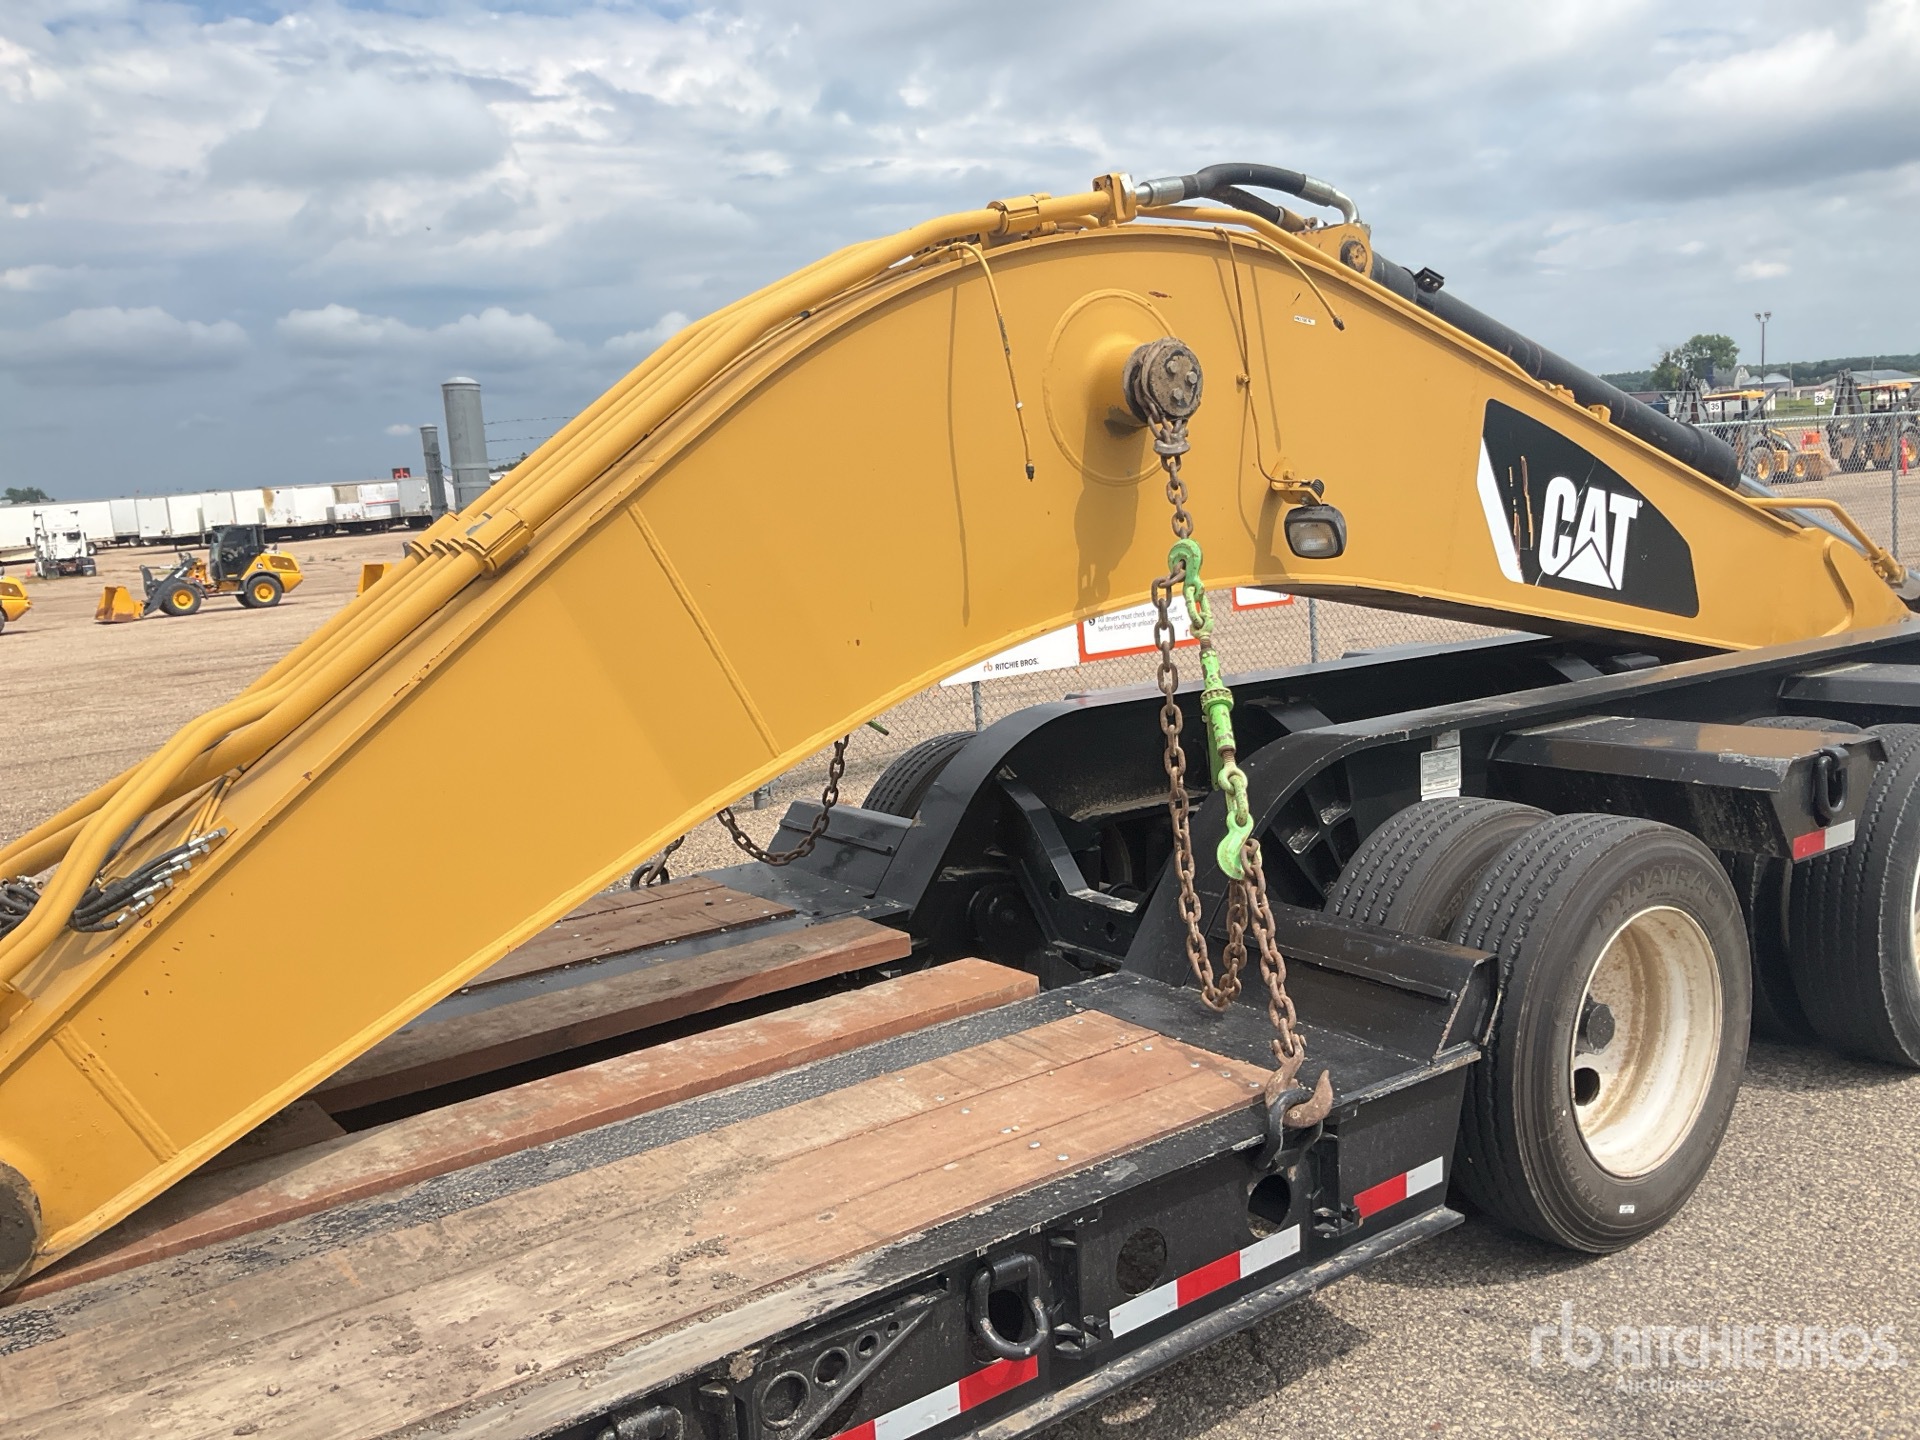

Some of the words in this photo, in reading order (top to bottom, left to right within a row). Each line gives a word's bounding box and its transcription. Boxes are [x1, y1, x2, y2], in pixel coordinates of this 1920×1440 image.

[1816, 395, 1824, 403] 36
[1539, 476, 1639, 590] CAT
[1121, 612, 1132, 620] must
[1098, 625, 1113, 633] before
[1114, 621, 1131, 630] loading
[983, 661, 993, 672] rb
[995, 660, 1019, 671] RITCHIE
